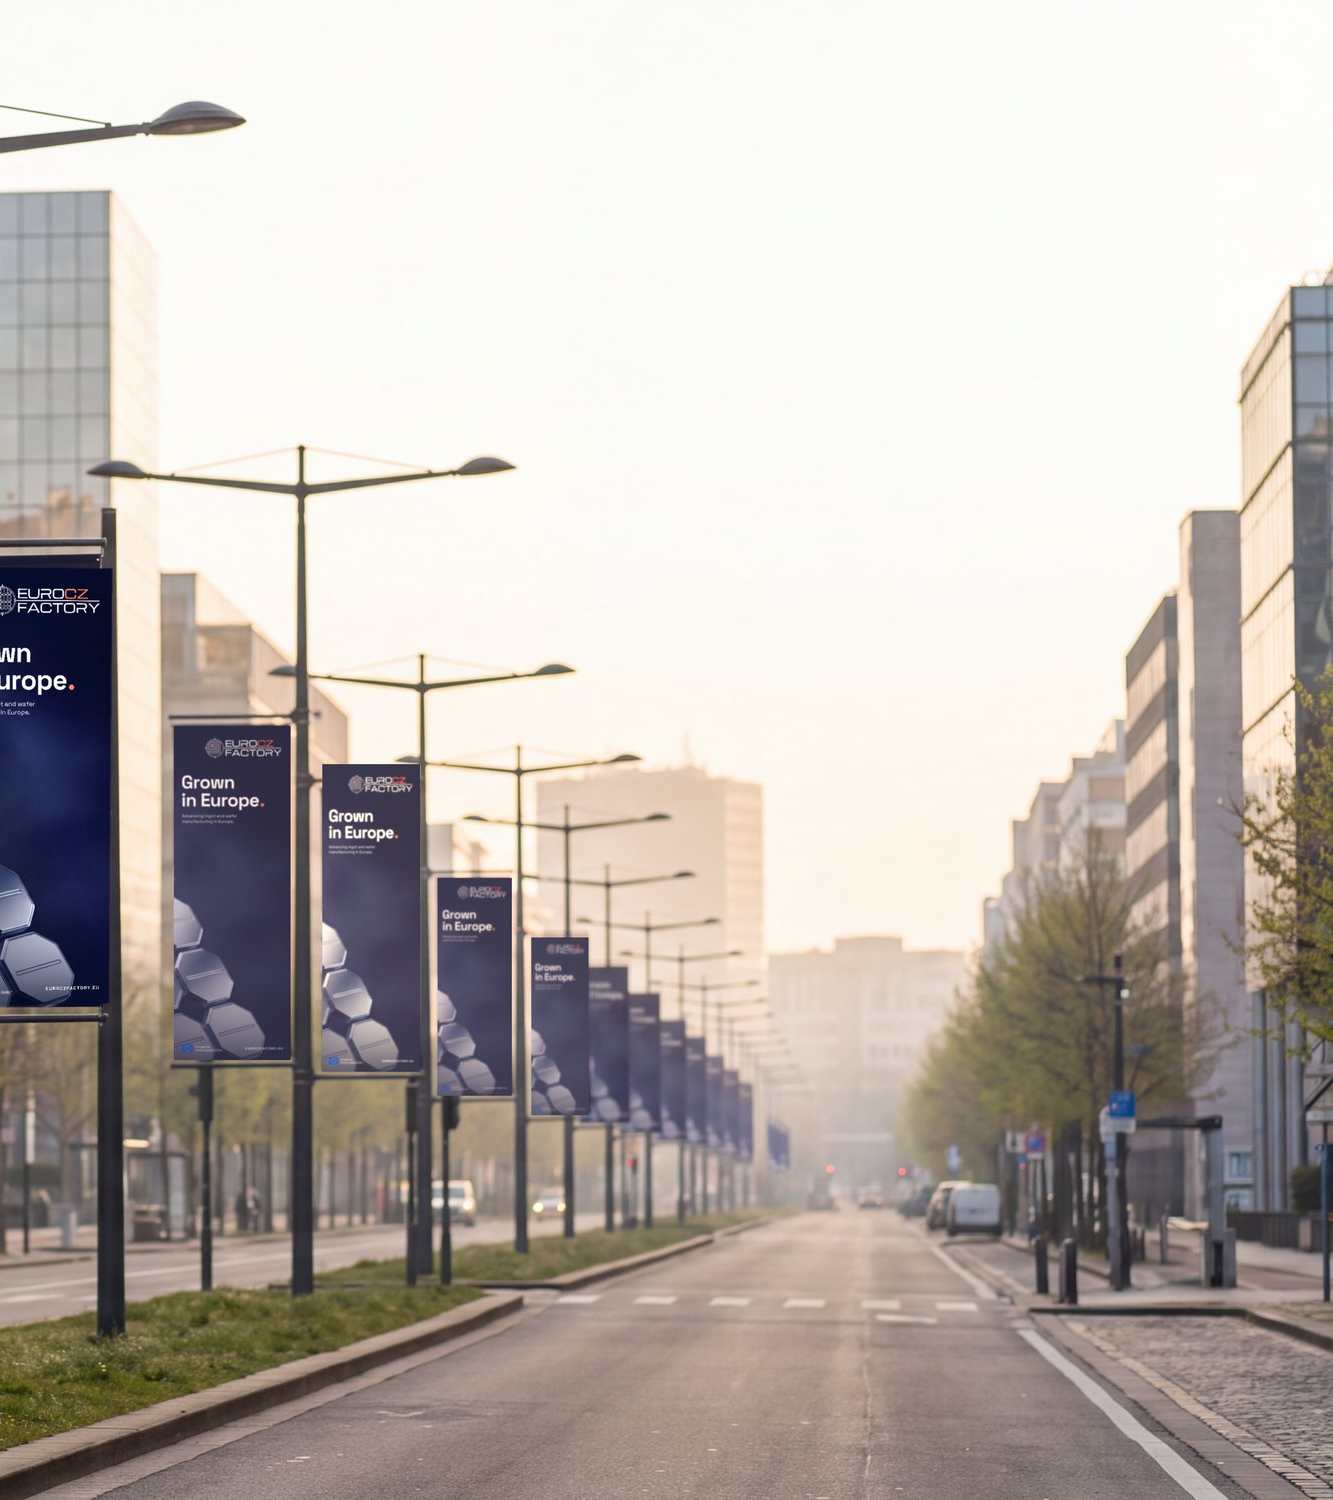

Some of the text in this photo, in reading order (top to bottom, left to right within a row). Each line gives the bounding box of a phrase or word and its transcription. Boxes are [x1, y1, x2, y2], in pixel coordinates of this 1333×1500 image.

[17, 588, 89, 600] EUROCZ
[17, 602, 100, 614] FACTORY
[225, 740, 274, 748] EUROCZ
[225, 749, 282, 757] FACTORY
[182, 775, 235, 790] Grown
[365, 785, 413, 793] FACTORY
[182, 793, 265, 811] in Europe.
[329, 809, 374, 823] Grown
[329, 826, 399, 842] in Europe.
[442, 909, 477, 919] Grown
[442, 921, 496, 933] in Europe.
